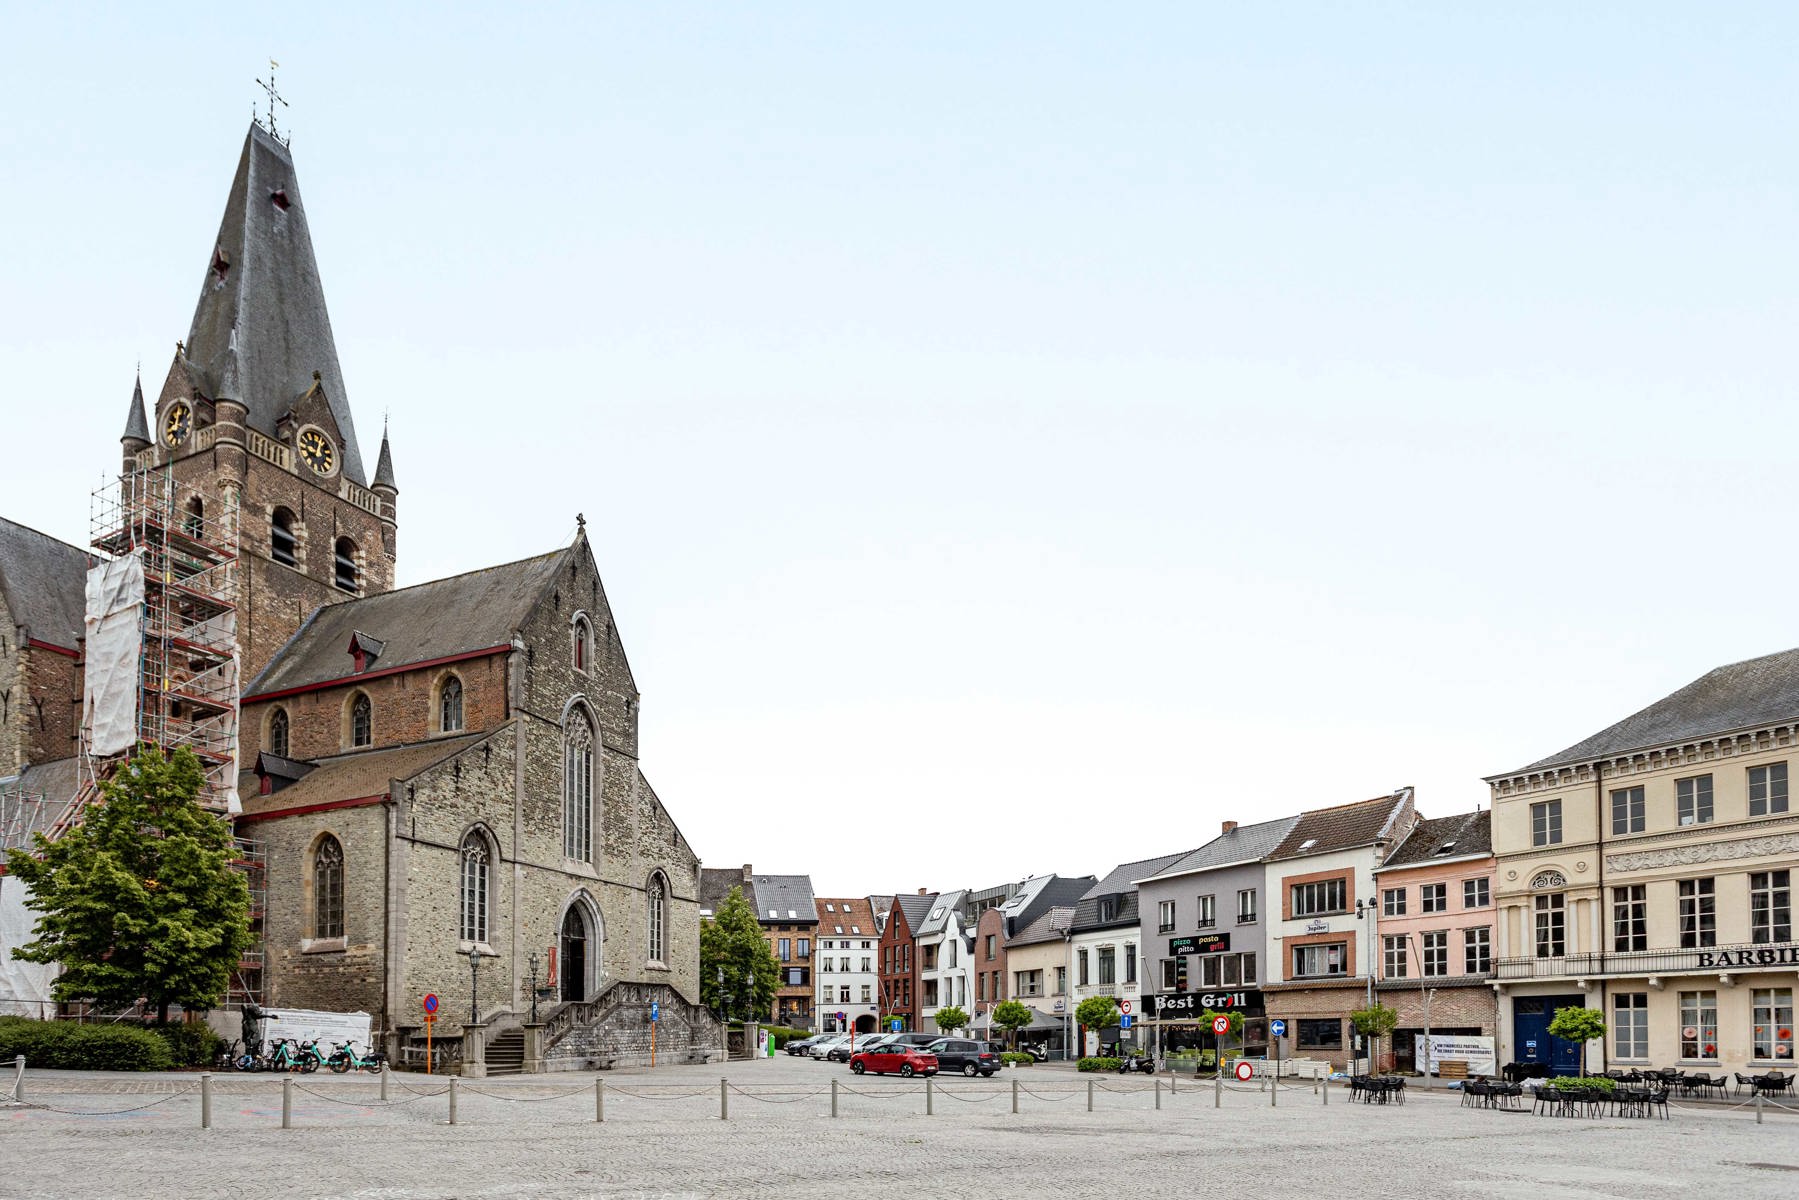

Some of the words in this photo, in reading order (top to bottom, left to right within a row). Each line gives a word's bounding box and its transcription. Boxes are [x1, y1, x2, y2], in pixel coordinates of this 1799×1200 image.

[1173, 938, 1191, 947] pizza
[1198, 936, 1219, 944] pasta
[1178, 945, 1194, 954] pitta
[1209, 942, 1224, 951] grill
[1154, 995, 1194, 1009] Best
